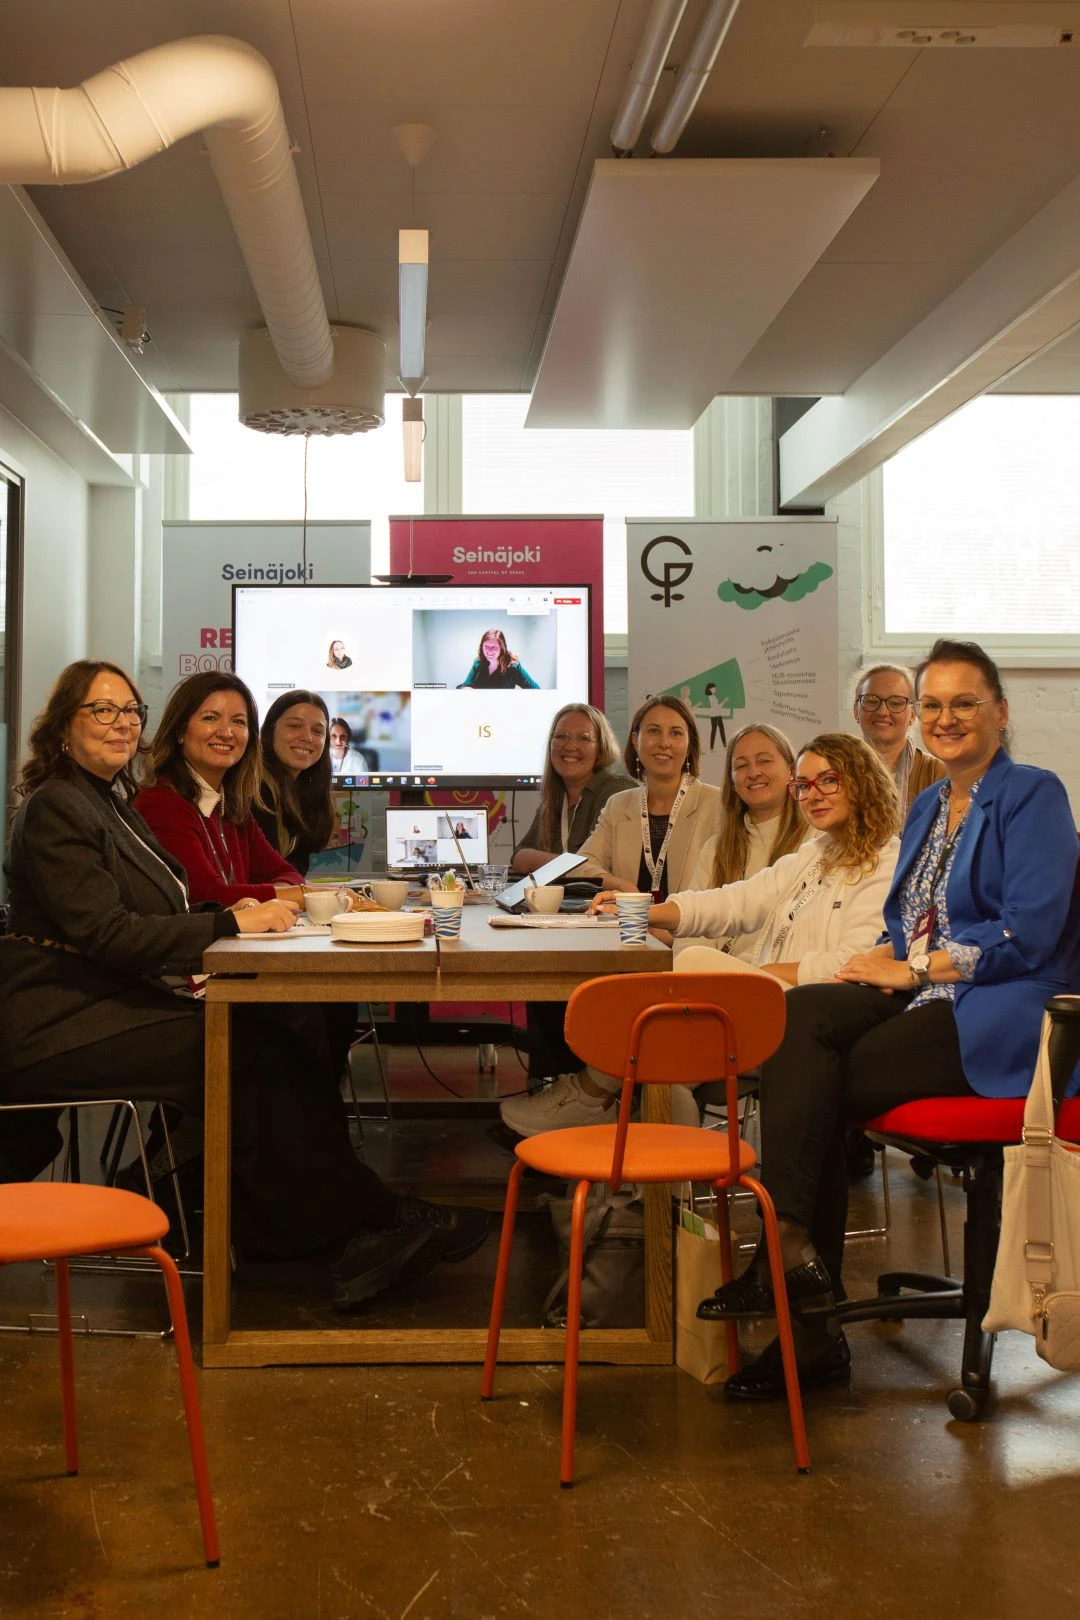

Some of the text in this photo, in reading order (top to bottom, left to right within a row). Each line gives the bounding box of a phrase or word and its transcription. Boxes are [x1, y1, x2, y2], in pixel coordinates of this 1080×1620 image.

[452, 545, 541, 568] Seinäjoki
[221, 563, 314, 585] Seinäjoki
[478, 725, 491, 738] IS
